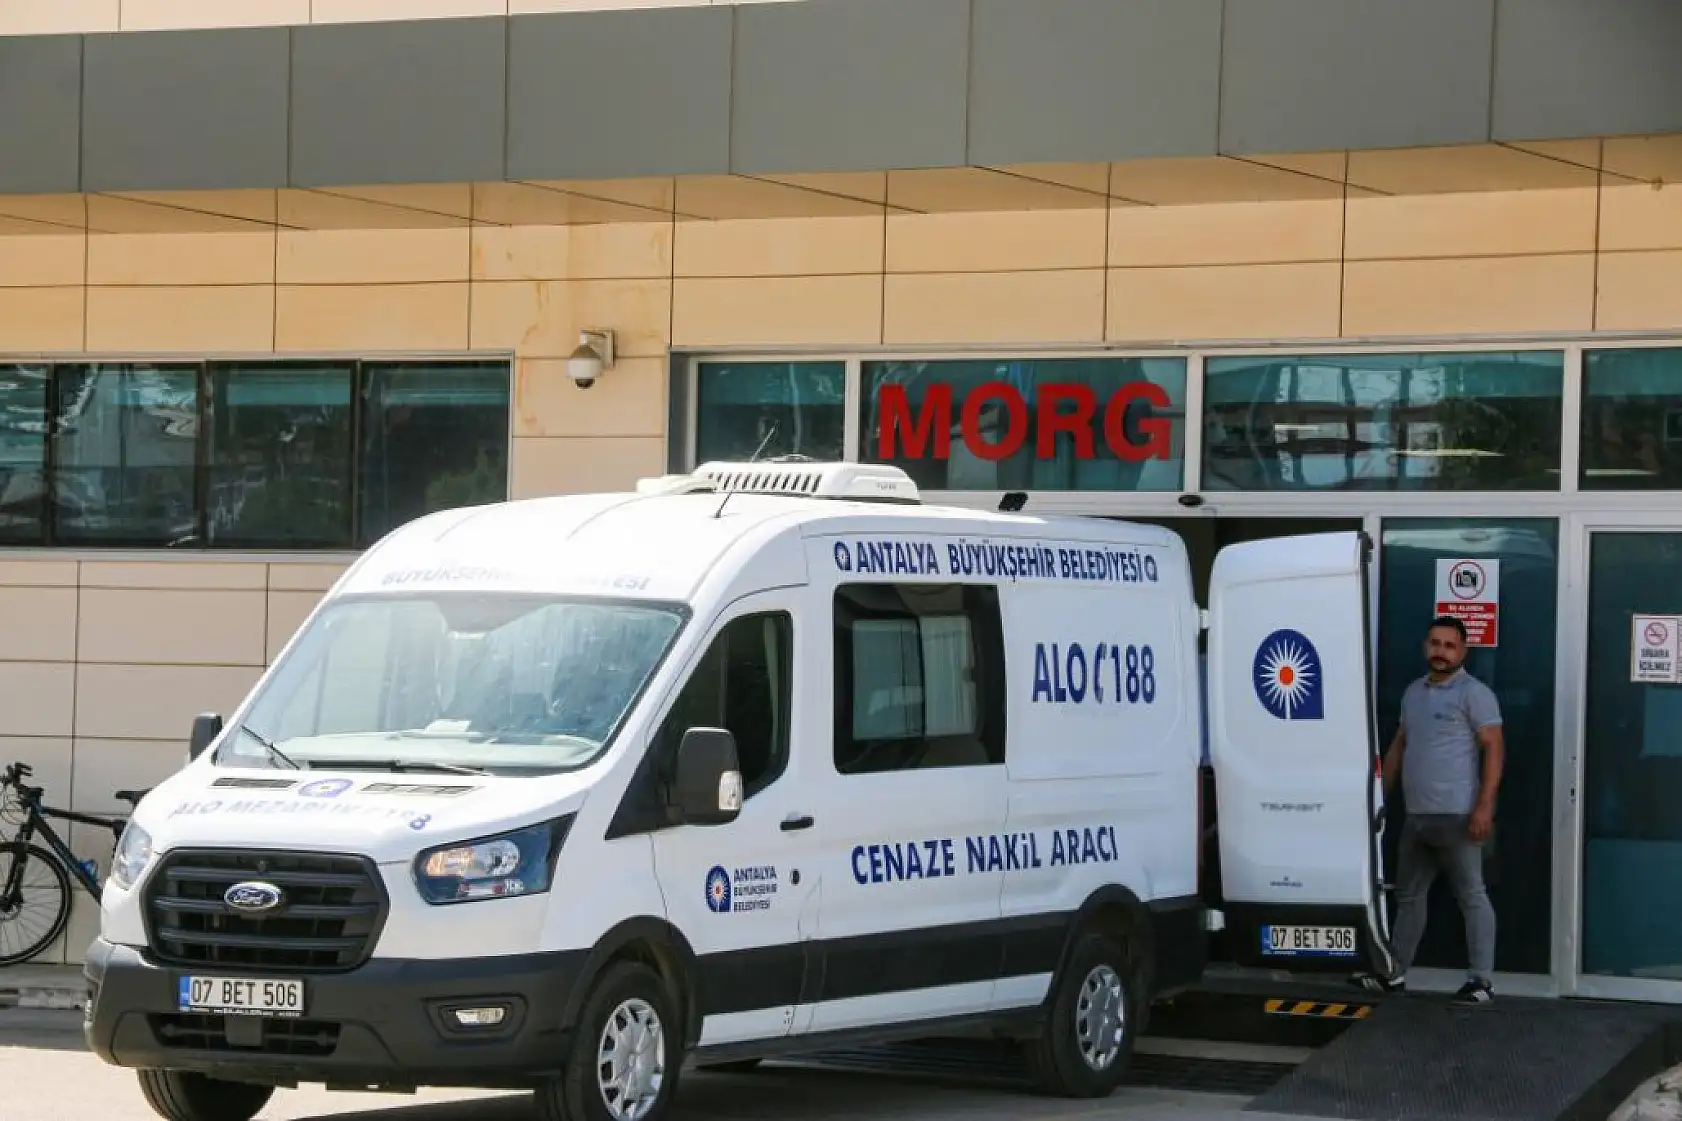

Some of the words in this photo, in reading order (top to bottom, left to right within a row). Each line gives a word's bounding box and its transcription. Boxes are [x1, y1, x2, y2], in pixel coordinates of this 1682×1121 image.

[877, 380, 1173, 462] MORG
[856, 541, 940, 575] ANTALYA
[948, 538, 1057, 582] BÜYÜKŞEHİR
[1060, 546, 1144, 583] BELEDİYESİ
[1032, 643, 1089, 704] ALO
[1109, 643, 1155, 704] 188
[734, 866, 778, 881] ANTALYA
[851, 838, 956, 885] CENAZE
[1050, 825, 1119, 867] ARACI
[1271, 927, 1287, 947] 07
[1294, 928, 1319, 948] BET
[1326, 929, 1353, 949] 506
[191, 979, 213, 1002] 07
[222, 980, 256, 1004] BET
[263, 983, 298, 1007] 506
